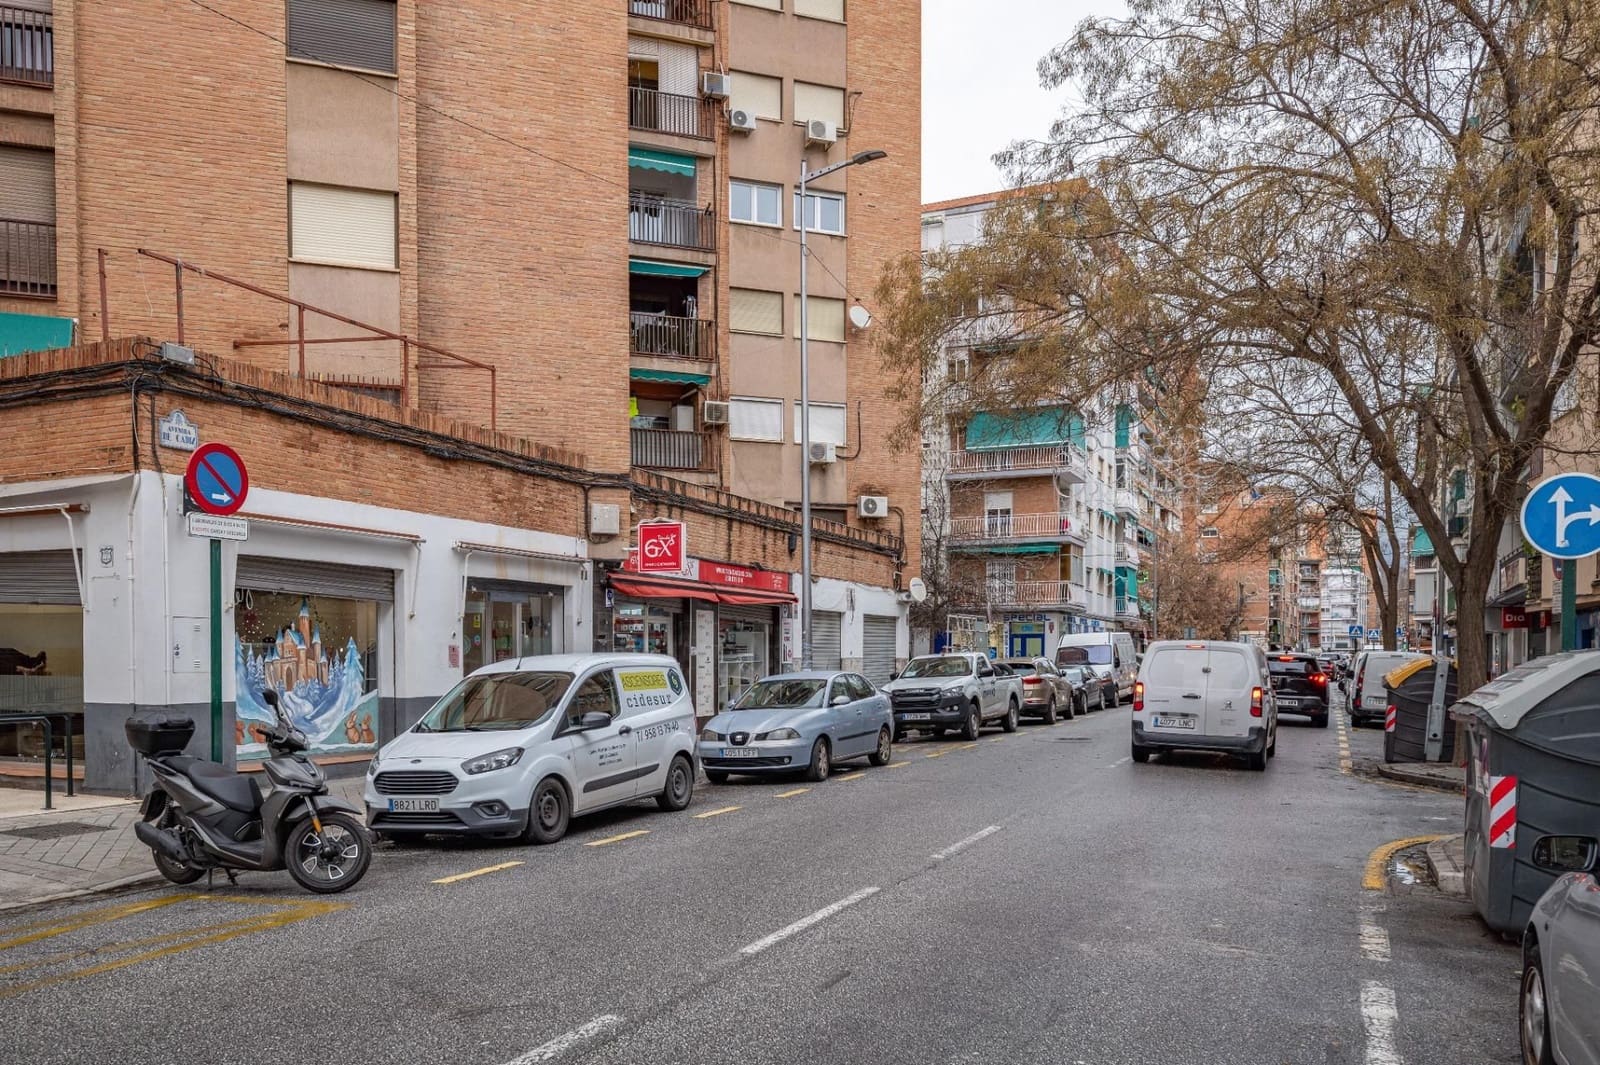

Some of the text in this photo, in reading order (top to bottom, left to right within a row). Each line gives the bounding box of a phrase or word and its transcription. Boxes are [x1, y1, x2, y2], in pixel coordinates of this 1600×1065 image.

[163, 432, 170, 440] DE
[621, 674, 667, 689] ASCENSORES
[626, 693, 673, 708] cidesur
[644, 727, 657, 740] 958
[671, 720, 679, 732] 40
[394, 800, 436, 810] 8821 LRD
